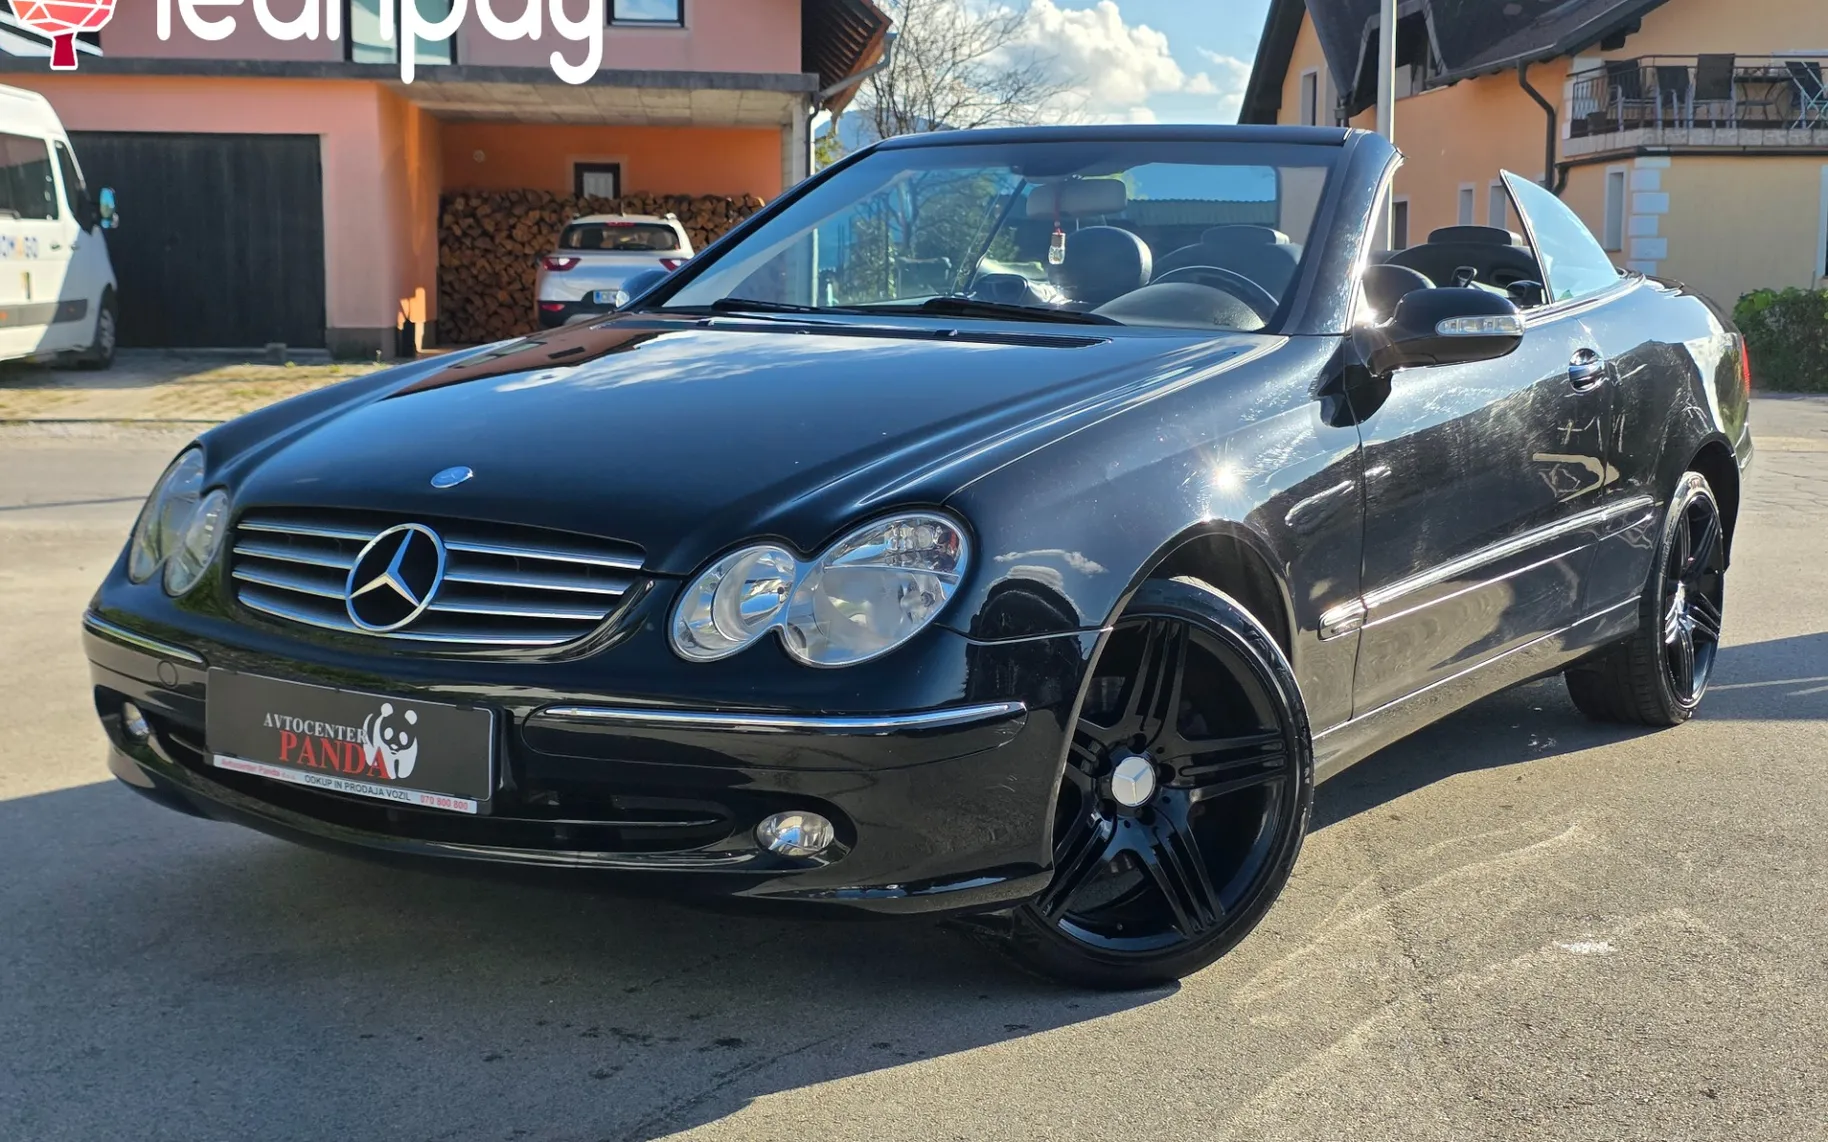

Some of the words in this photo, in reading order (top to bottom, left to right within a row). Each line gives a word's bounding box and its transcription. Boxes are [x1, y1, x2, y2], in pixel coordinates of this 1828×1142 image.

[263, 712, 369, 745] AVTOCENTER
[278, 730, 391, 780] PANDA
[304, 775, 332, 787] ODKUP
[334, 781, 343, 789] IN
[344, 783, 384, 796] PRODAJA
[386, 790, 411, 801] VOZIL
